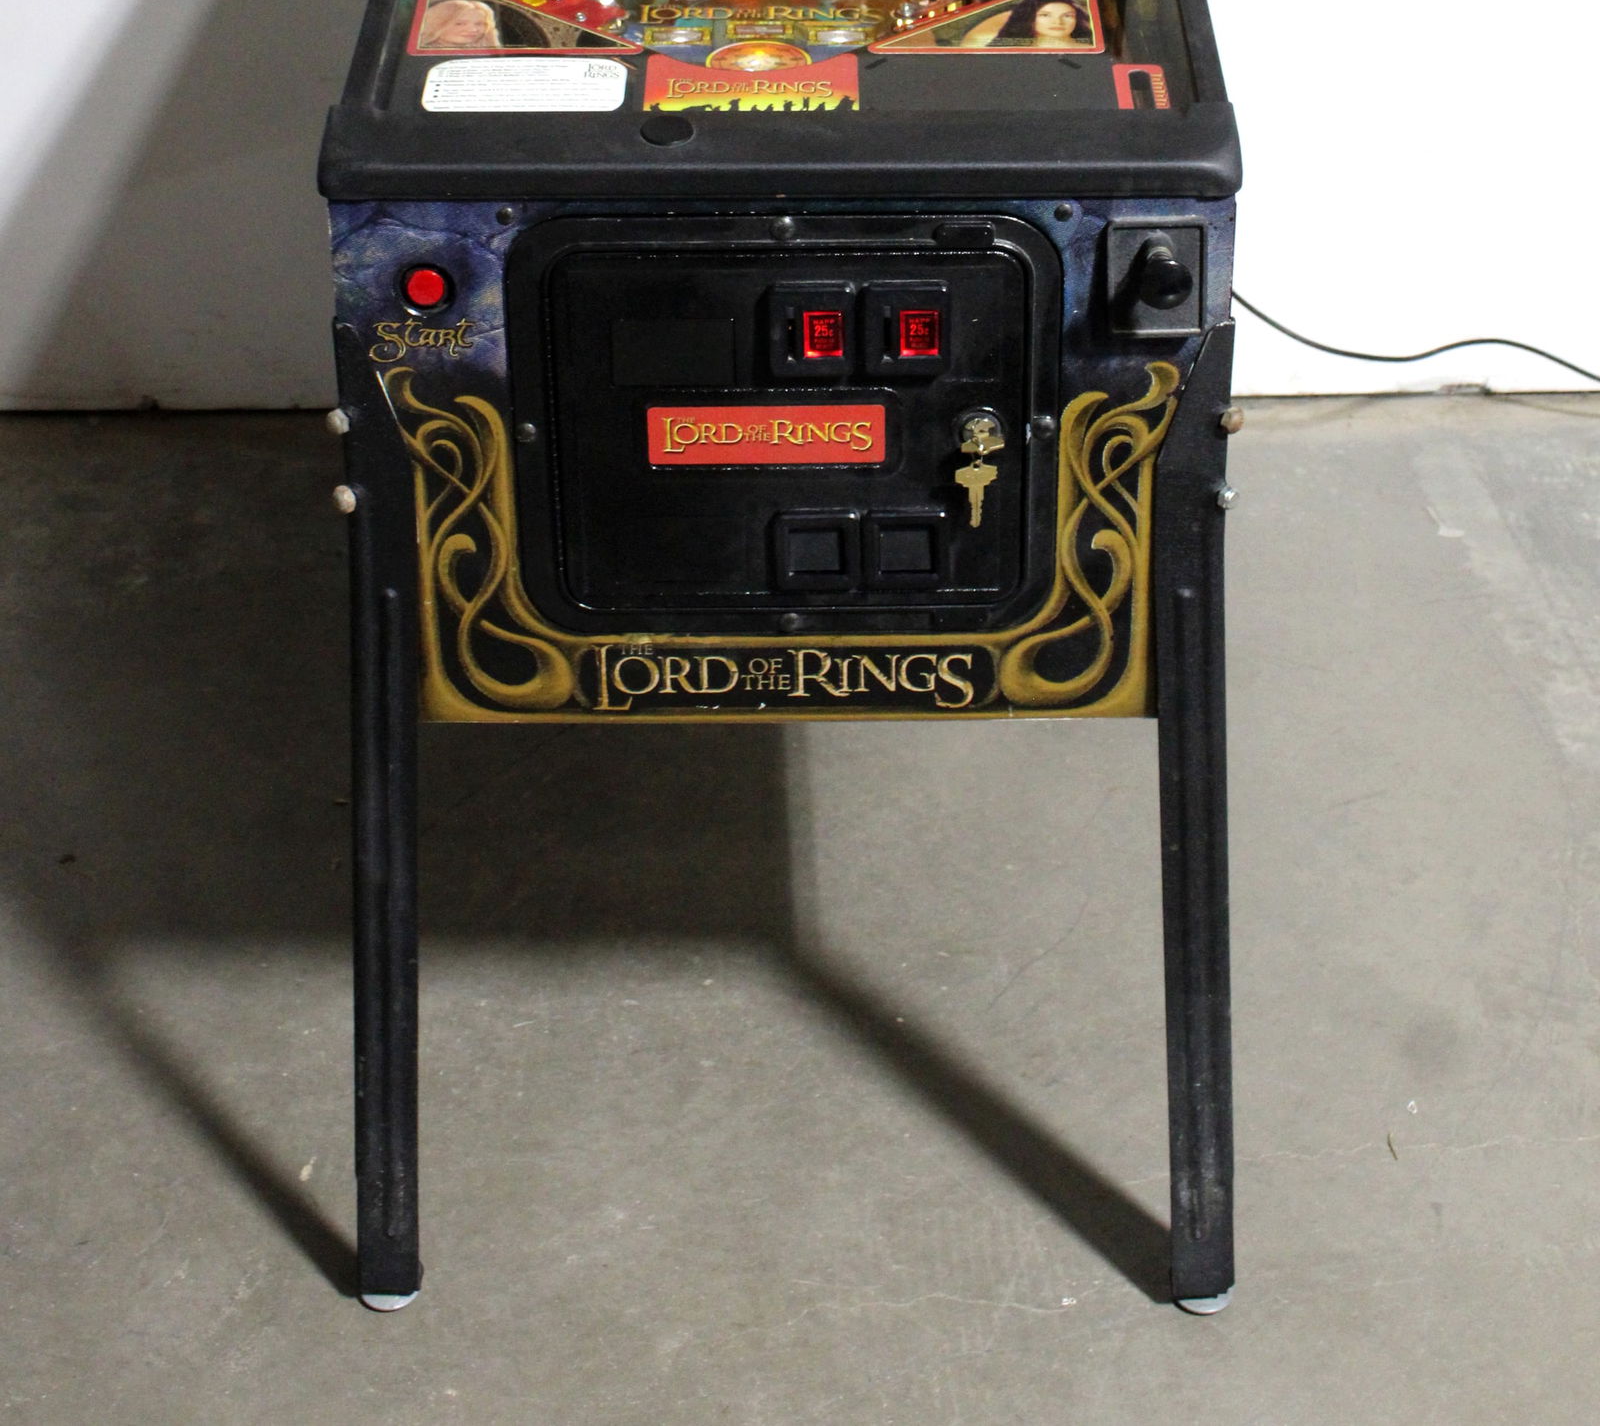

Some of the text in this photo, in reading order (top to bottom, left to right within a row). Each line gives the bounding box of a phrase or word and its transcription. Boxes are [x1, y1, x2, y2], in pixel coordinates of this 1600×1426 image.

[639, 5, 733, 23] LORD
[667, 78, 730, 98] LORD
[752, 79, 832, 97] RINGS
[661, 417, 743, 452] LORD
[743, 432, 771, 442] THE
[770, 420, 872, 451] RINGS
[592, 644, 974, 711] LORD OF THE RINGS
